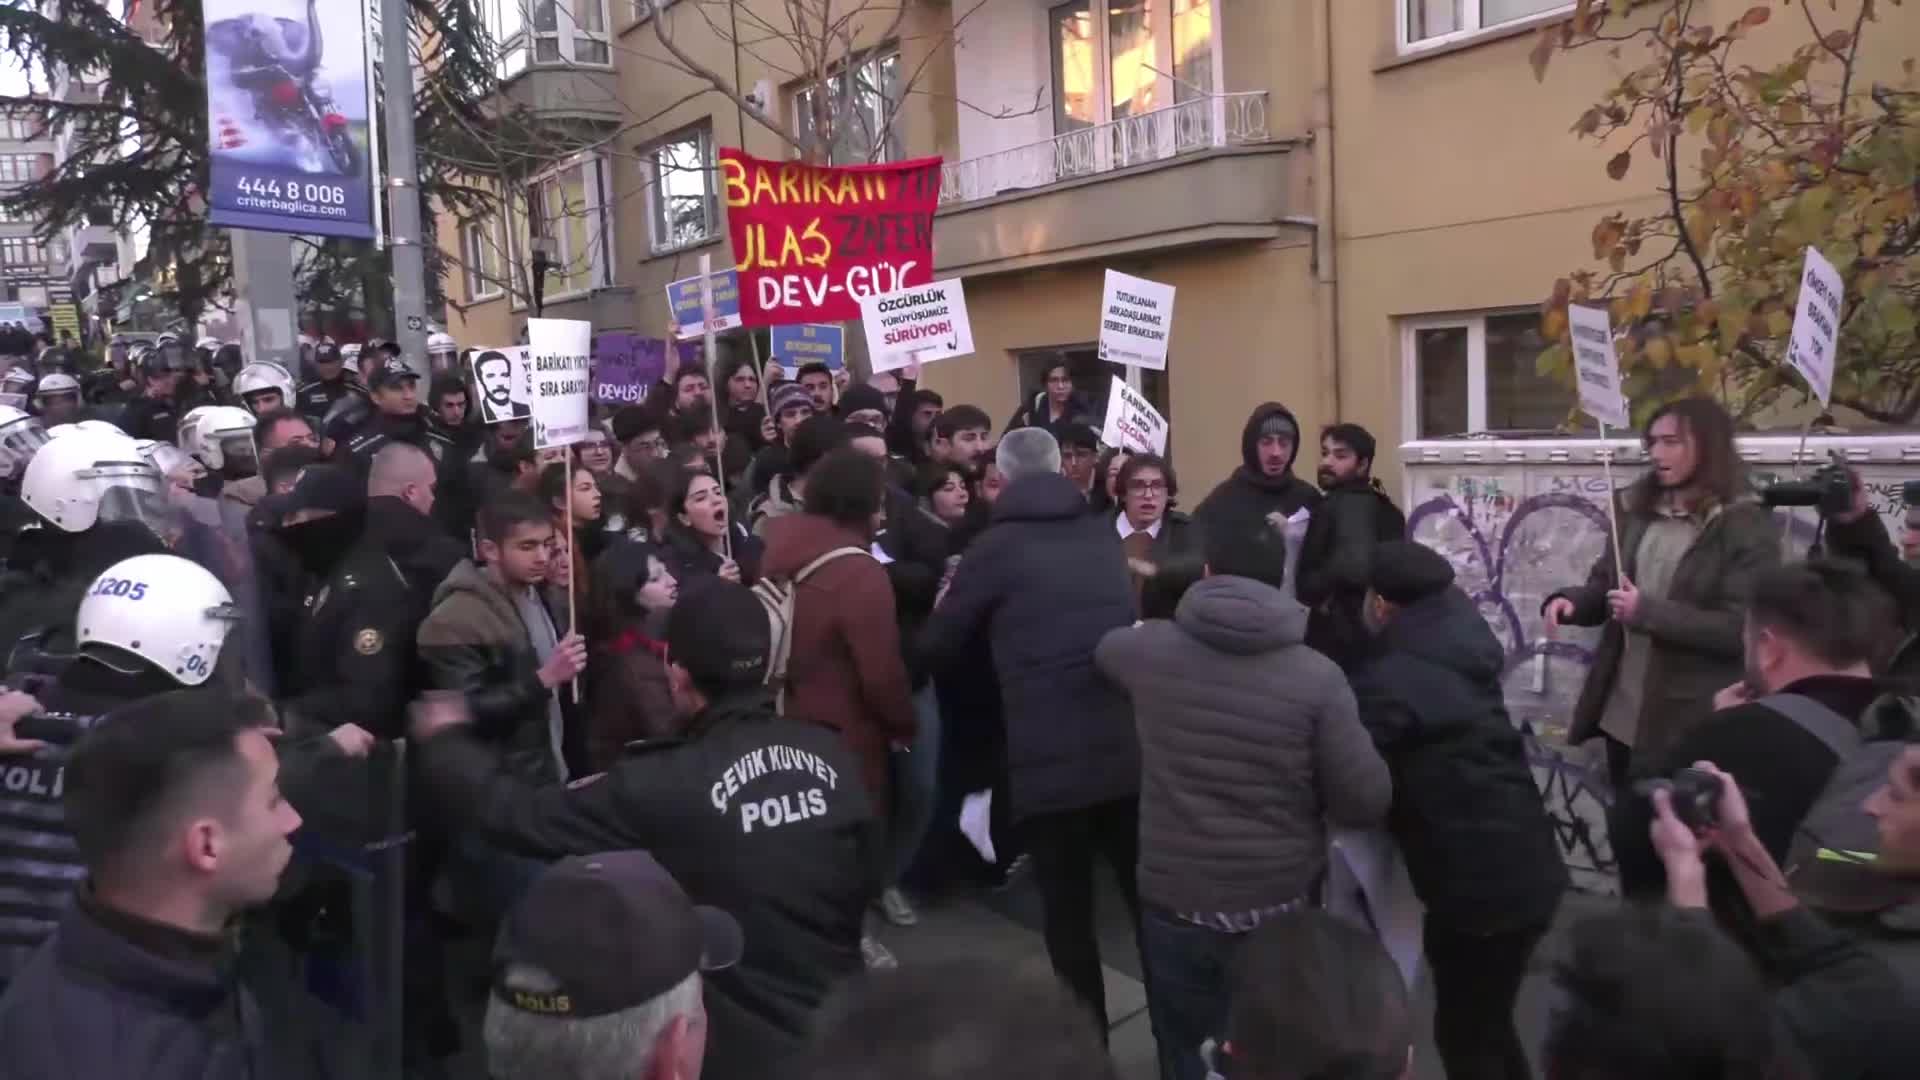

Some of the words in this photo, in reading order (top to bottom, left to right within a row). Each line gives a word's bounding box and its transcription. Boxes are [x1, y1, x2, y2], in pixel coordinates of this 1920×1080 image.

[237, 176, 281, 198] 444
[287, 181, 300, 200] 8
[305, 184, 345, 204] 006
[237, 195, 347, 216] criterbaglica.com
[881, 306, 949, 327] YÜRÜYÜŞÜMÜZ
[884, 319, 952, 345] SÜRÜYOR!
[540, 381, 560, 397] SIRA
[711, 748, 769, 815] ÇEVİK
[767, 744, 839, 791] KUVVET
[740, 787, 828, 834] POLİS
